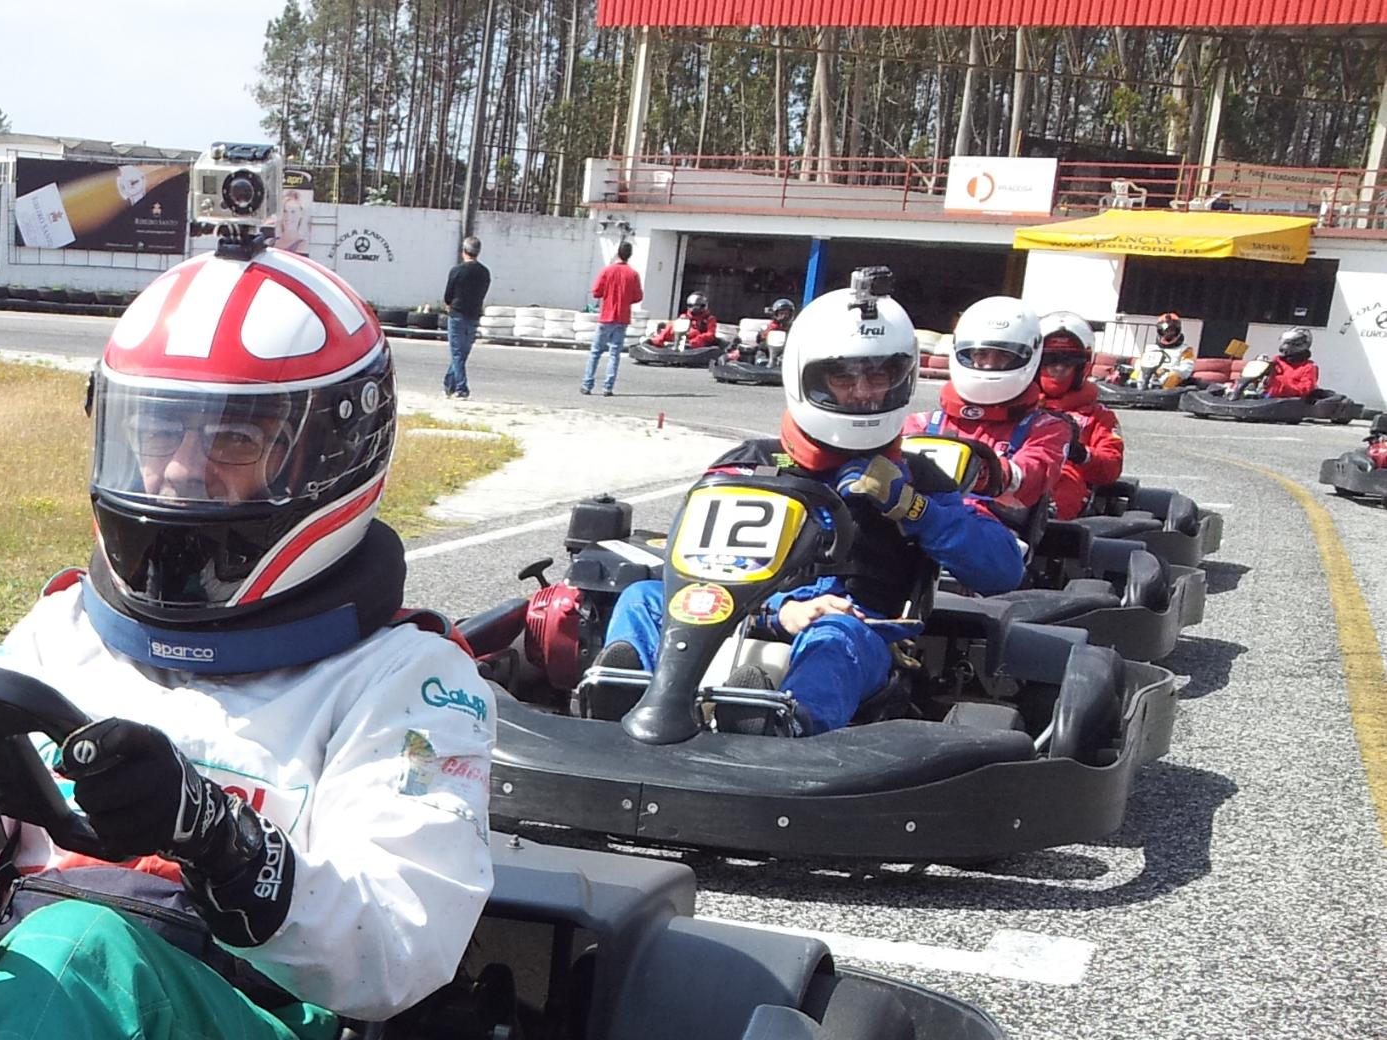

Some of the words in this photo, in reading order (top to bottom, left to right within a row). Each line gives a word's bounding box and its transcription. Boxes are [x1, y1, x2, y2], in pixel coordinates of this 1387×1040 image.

[909, 494, 925, 519] OMP
[699, 500, 774, 549] 12
[152, 642, 214, 659] sparco
